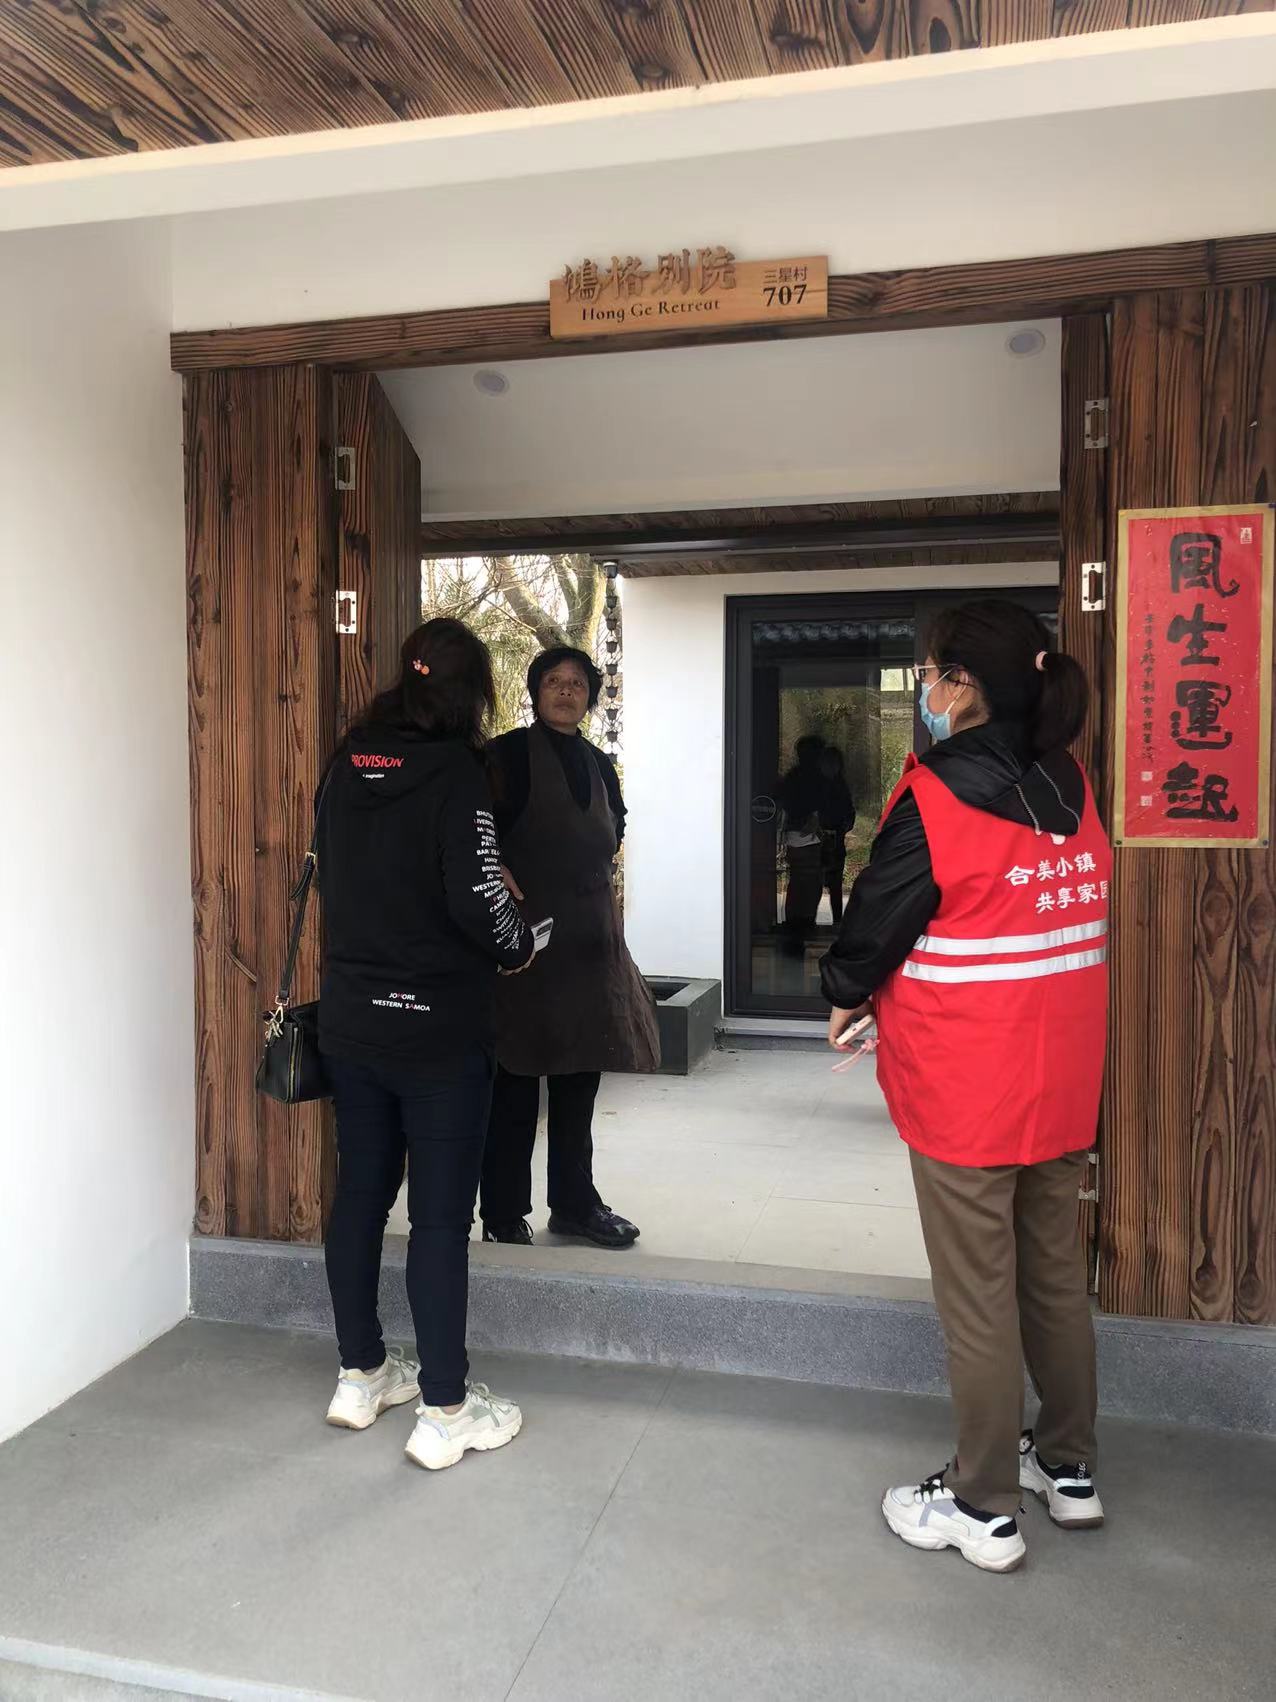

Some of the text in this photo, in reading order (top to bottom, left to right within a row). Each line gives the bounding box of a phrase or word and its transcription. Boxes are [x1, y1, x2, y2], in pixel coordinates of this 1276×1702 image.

[763, 266, 808, 285] 三星村
[762, 284, 808, 307] 707
[582, 298, 721, 323] Hong Ge Retreat
[1004, 852, 1097, 886] 合美小镇
[372, 999, 403, 1008] WESTERN
